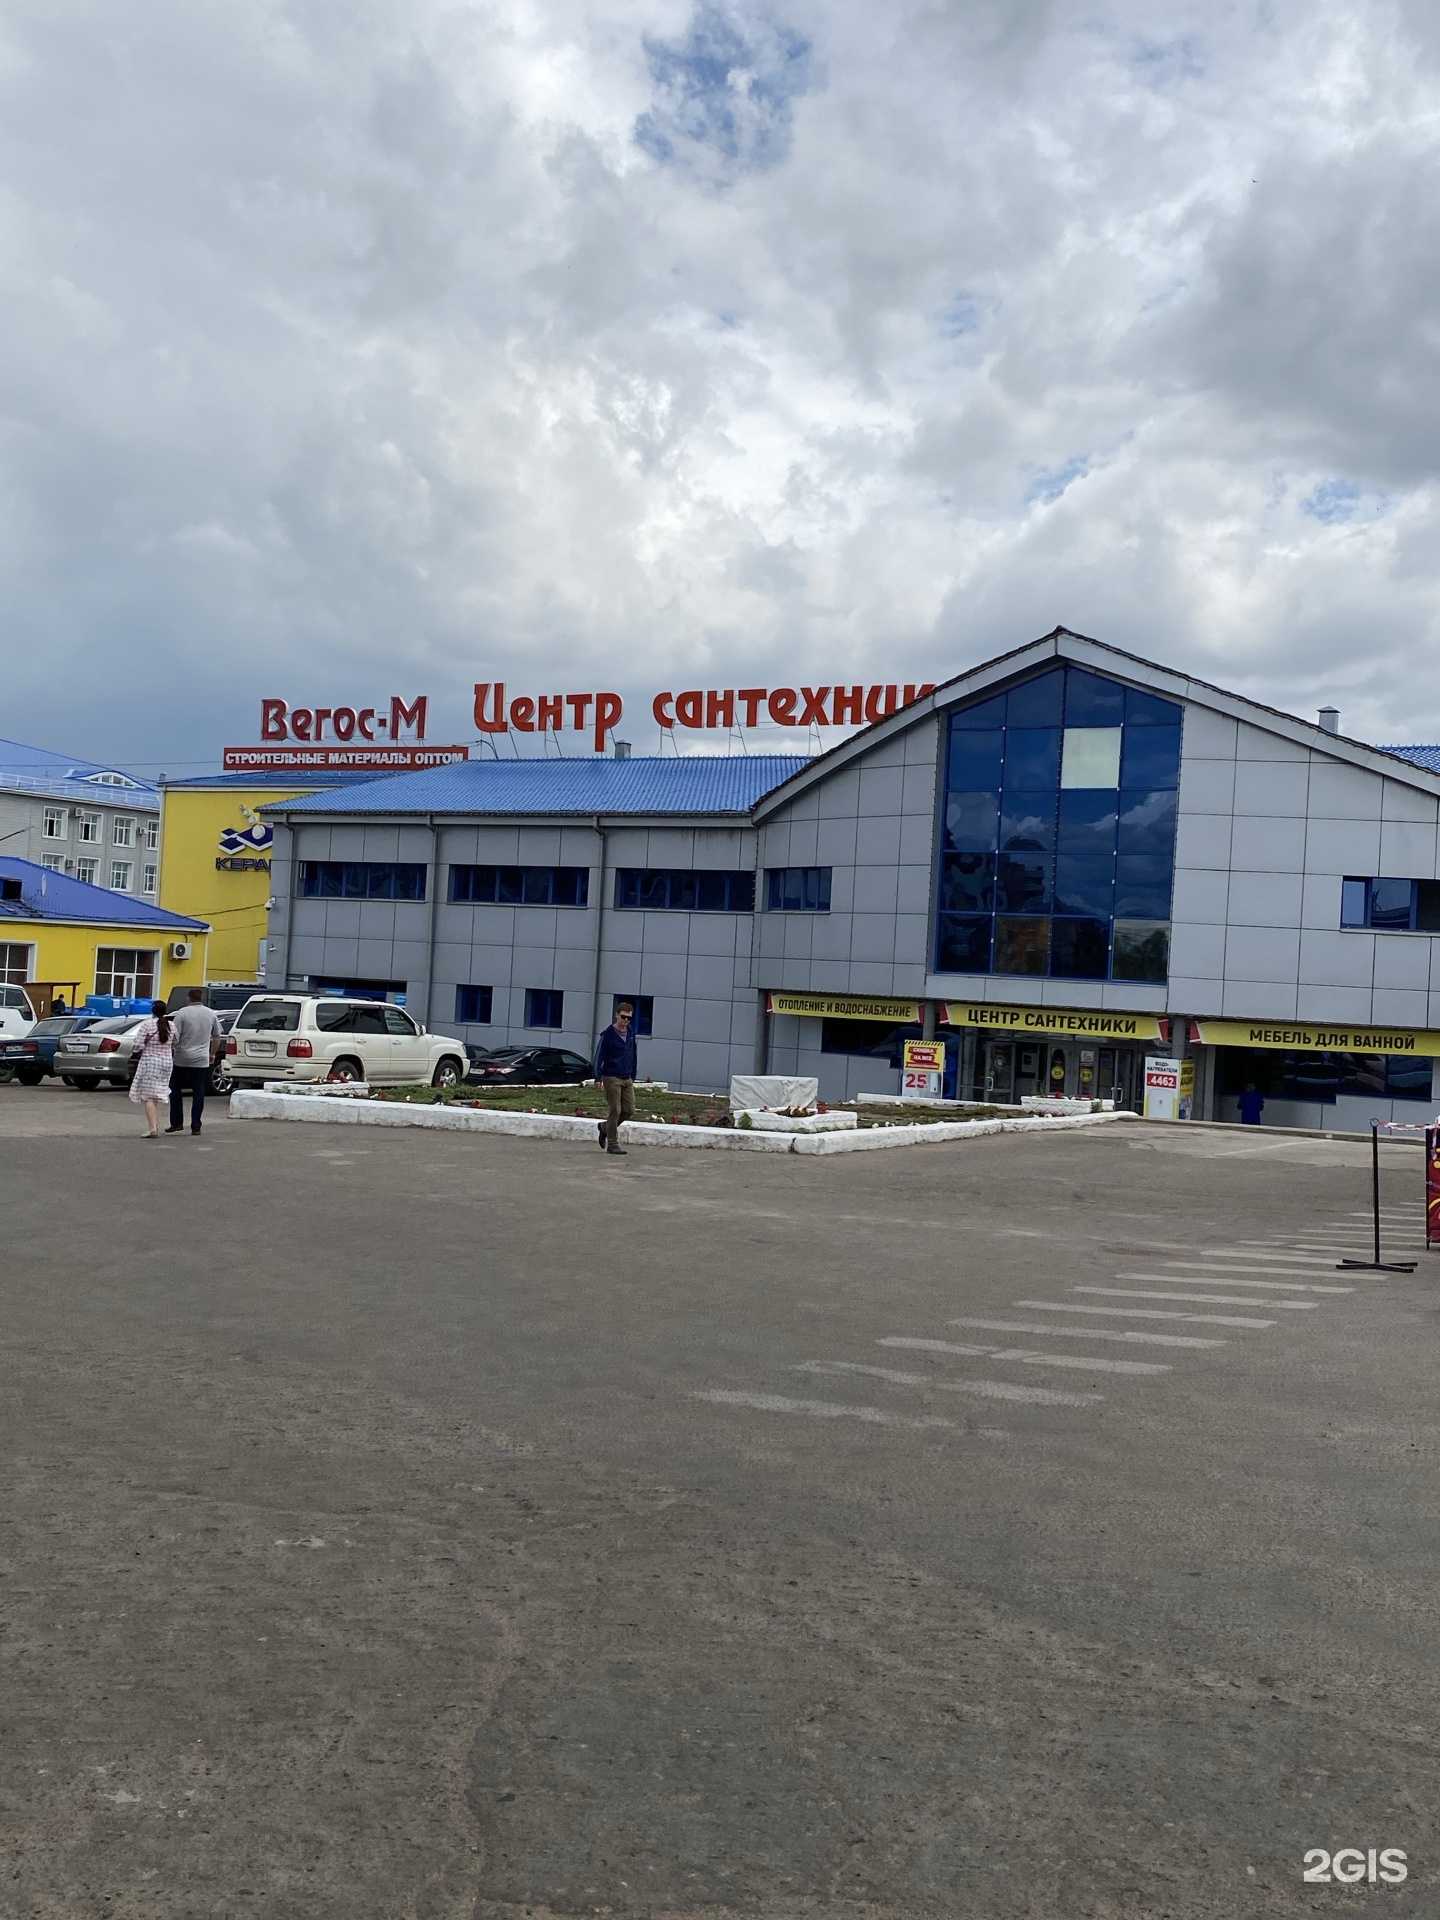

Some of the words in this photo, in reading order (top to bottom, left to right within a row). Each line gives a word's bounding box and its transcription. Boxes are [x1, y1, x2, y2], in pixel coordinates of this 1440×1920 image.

[261, 696, 429, 742] Вегос-М
[474, 682, 624, 753] Центр
[225, 752, 326, 764] СТРОИТЕЛЬНЫЕ
[328, 752, 411, 764] МАТЕРИАЛЫ
[415, 752, 464, 764] ОПТОМ
[215, 857, 272, 872] КЕРА
[778, 998, 825, 1012] ОТОПЛЕНИЕ
[826, 1003, 833, 1012] И
[834, 1003, 911, 1017] ВОДОСНАБЖЕНИЕ
[968, 1009, 1020, 1024] ЦЕНТР
[1024, 1013, 1137, 1034] САНТЕХНИКИ
[1250, 1029, 1312, 1044] МЕБЕЛЬ
[1315, 1033, 1348, 1047] ДЛЯ
[1353, 1034, 1415, 1049] ВАННОЙ
[905, 1073, 927, 1088] 25
